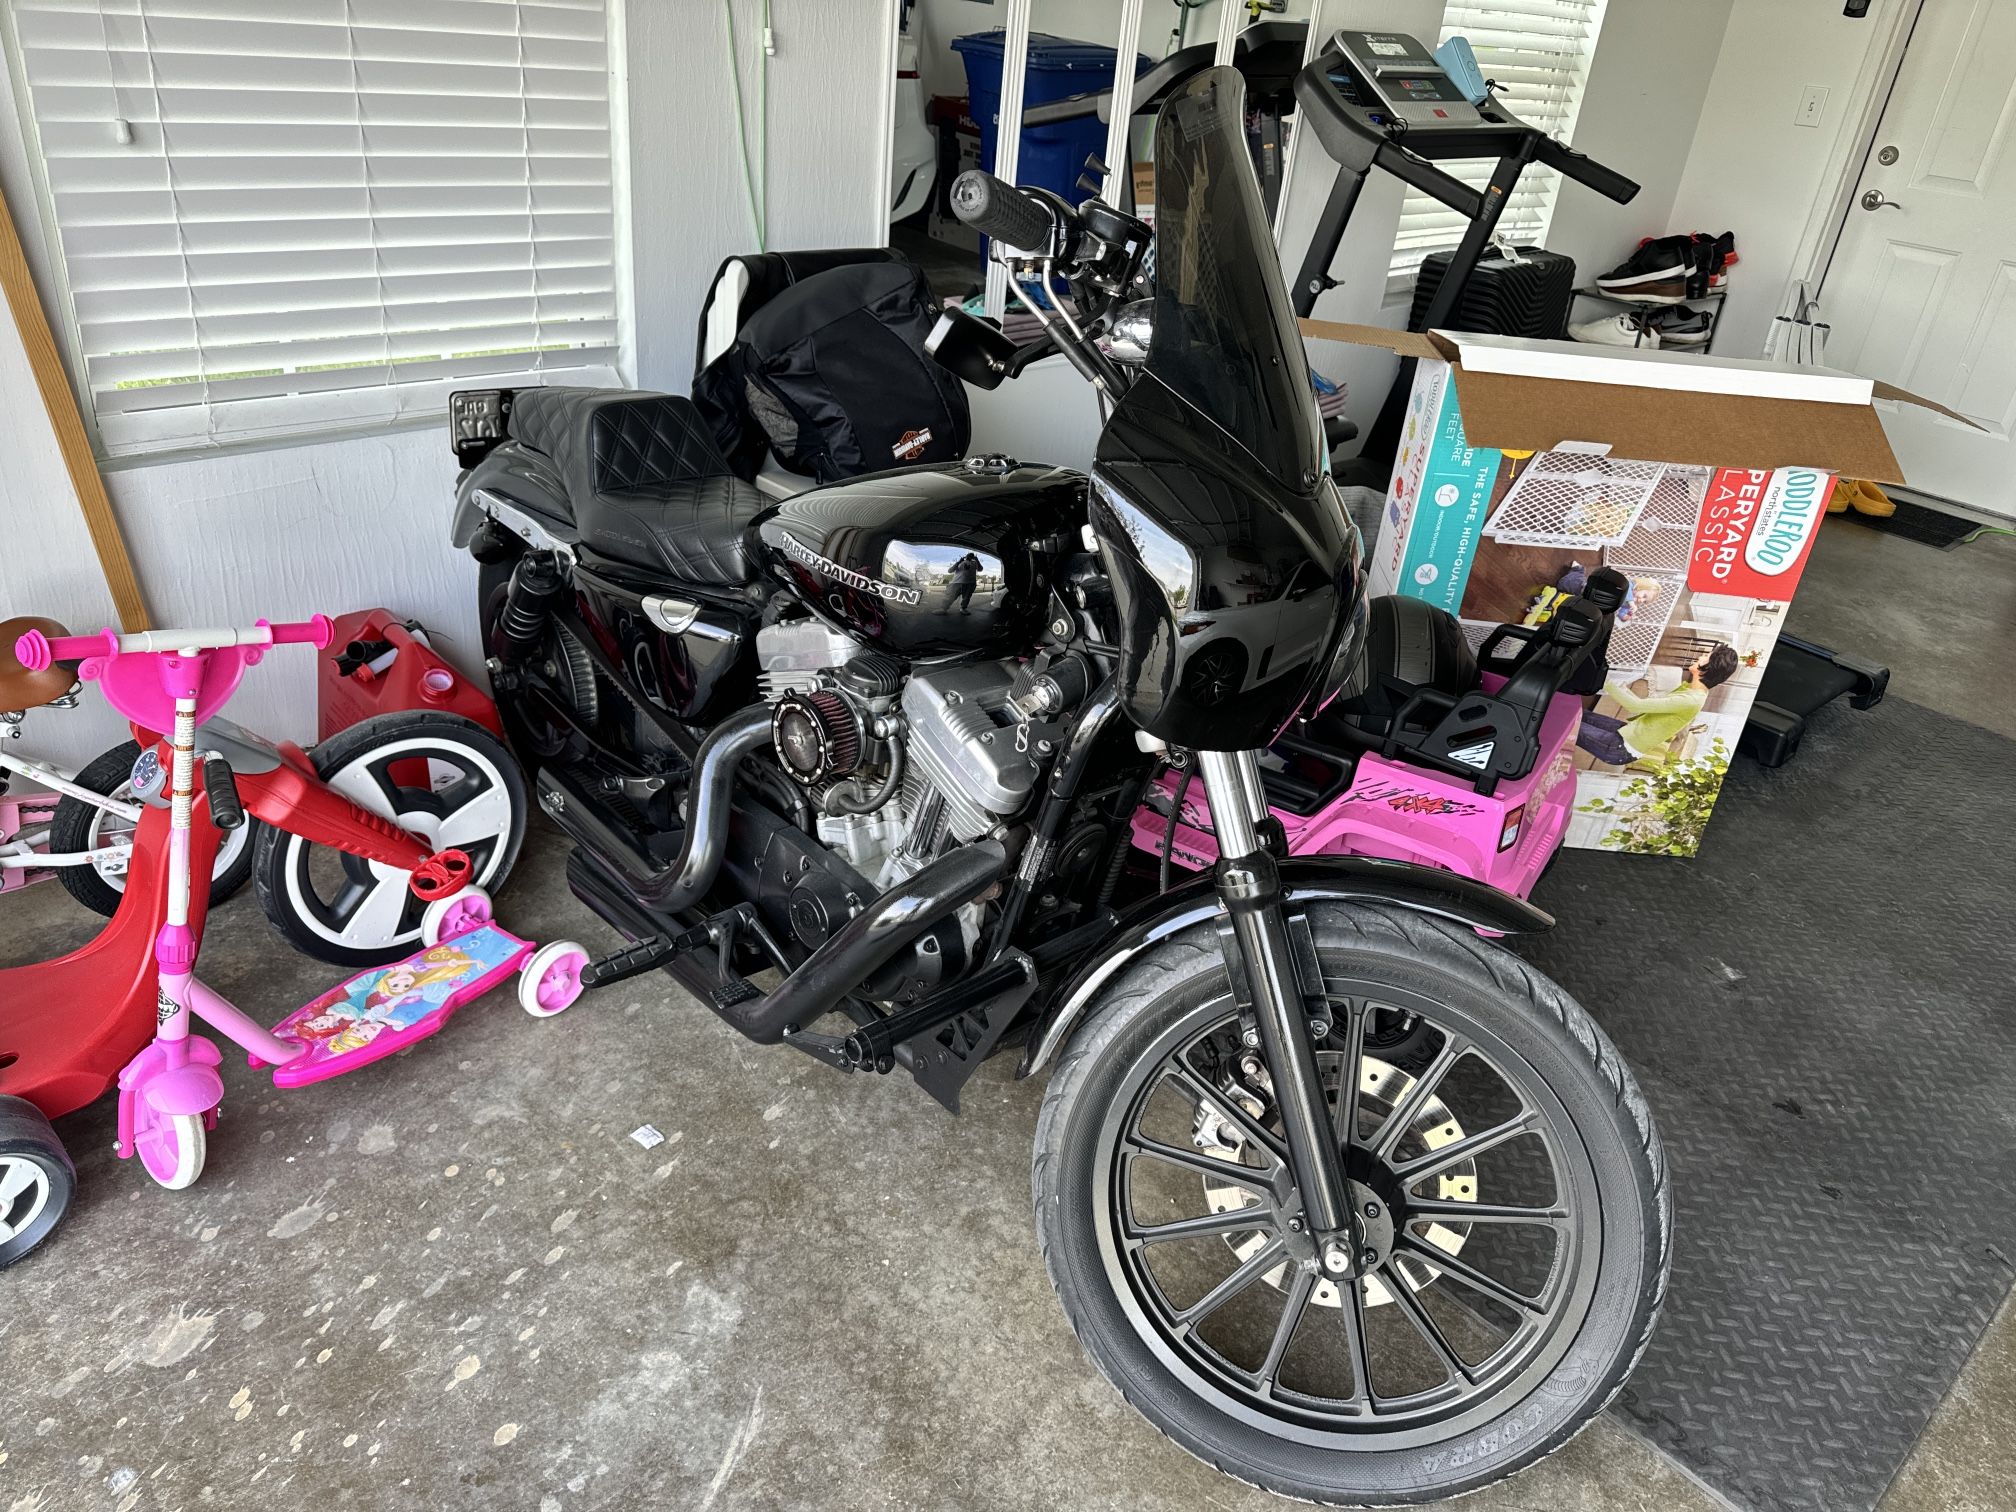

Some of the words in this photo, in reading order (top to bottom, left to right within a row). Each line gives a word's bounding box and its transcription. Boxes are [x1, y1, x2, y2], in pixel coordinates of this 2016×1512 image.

[1445, 412, 1460, 441] FEET
[1450, 423, 1466, 462] QUARE
[1461, 448, 1474, 468] IDE
[1391, 443, 1425, 572] SUPERYARD
[1464, 491, 1482, 524] SAFE,
[1475, 466, 1489, 489] THE
[1694, 469, 1744, 563] LASSIC
[1712, 469, 1767, 579] PERYARD
[1756, 470, 1818, 567] ODDLEROO
[780, 531, 922, 605] HARLEY-DAVIDSON
[1444, 527, 1473, 605] HIGH-QUALITY
[1421, 1402, 1544, 1474] COBRA
